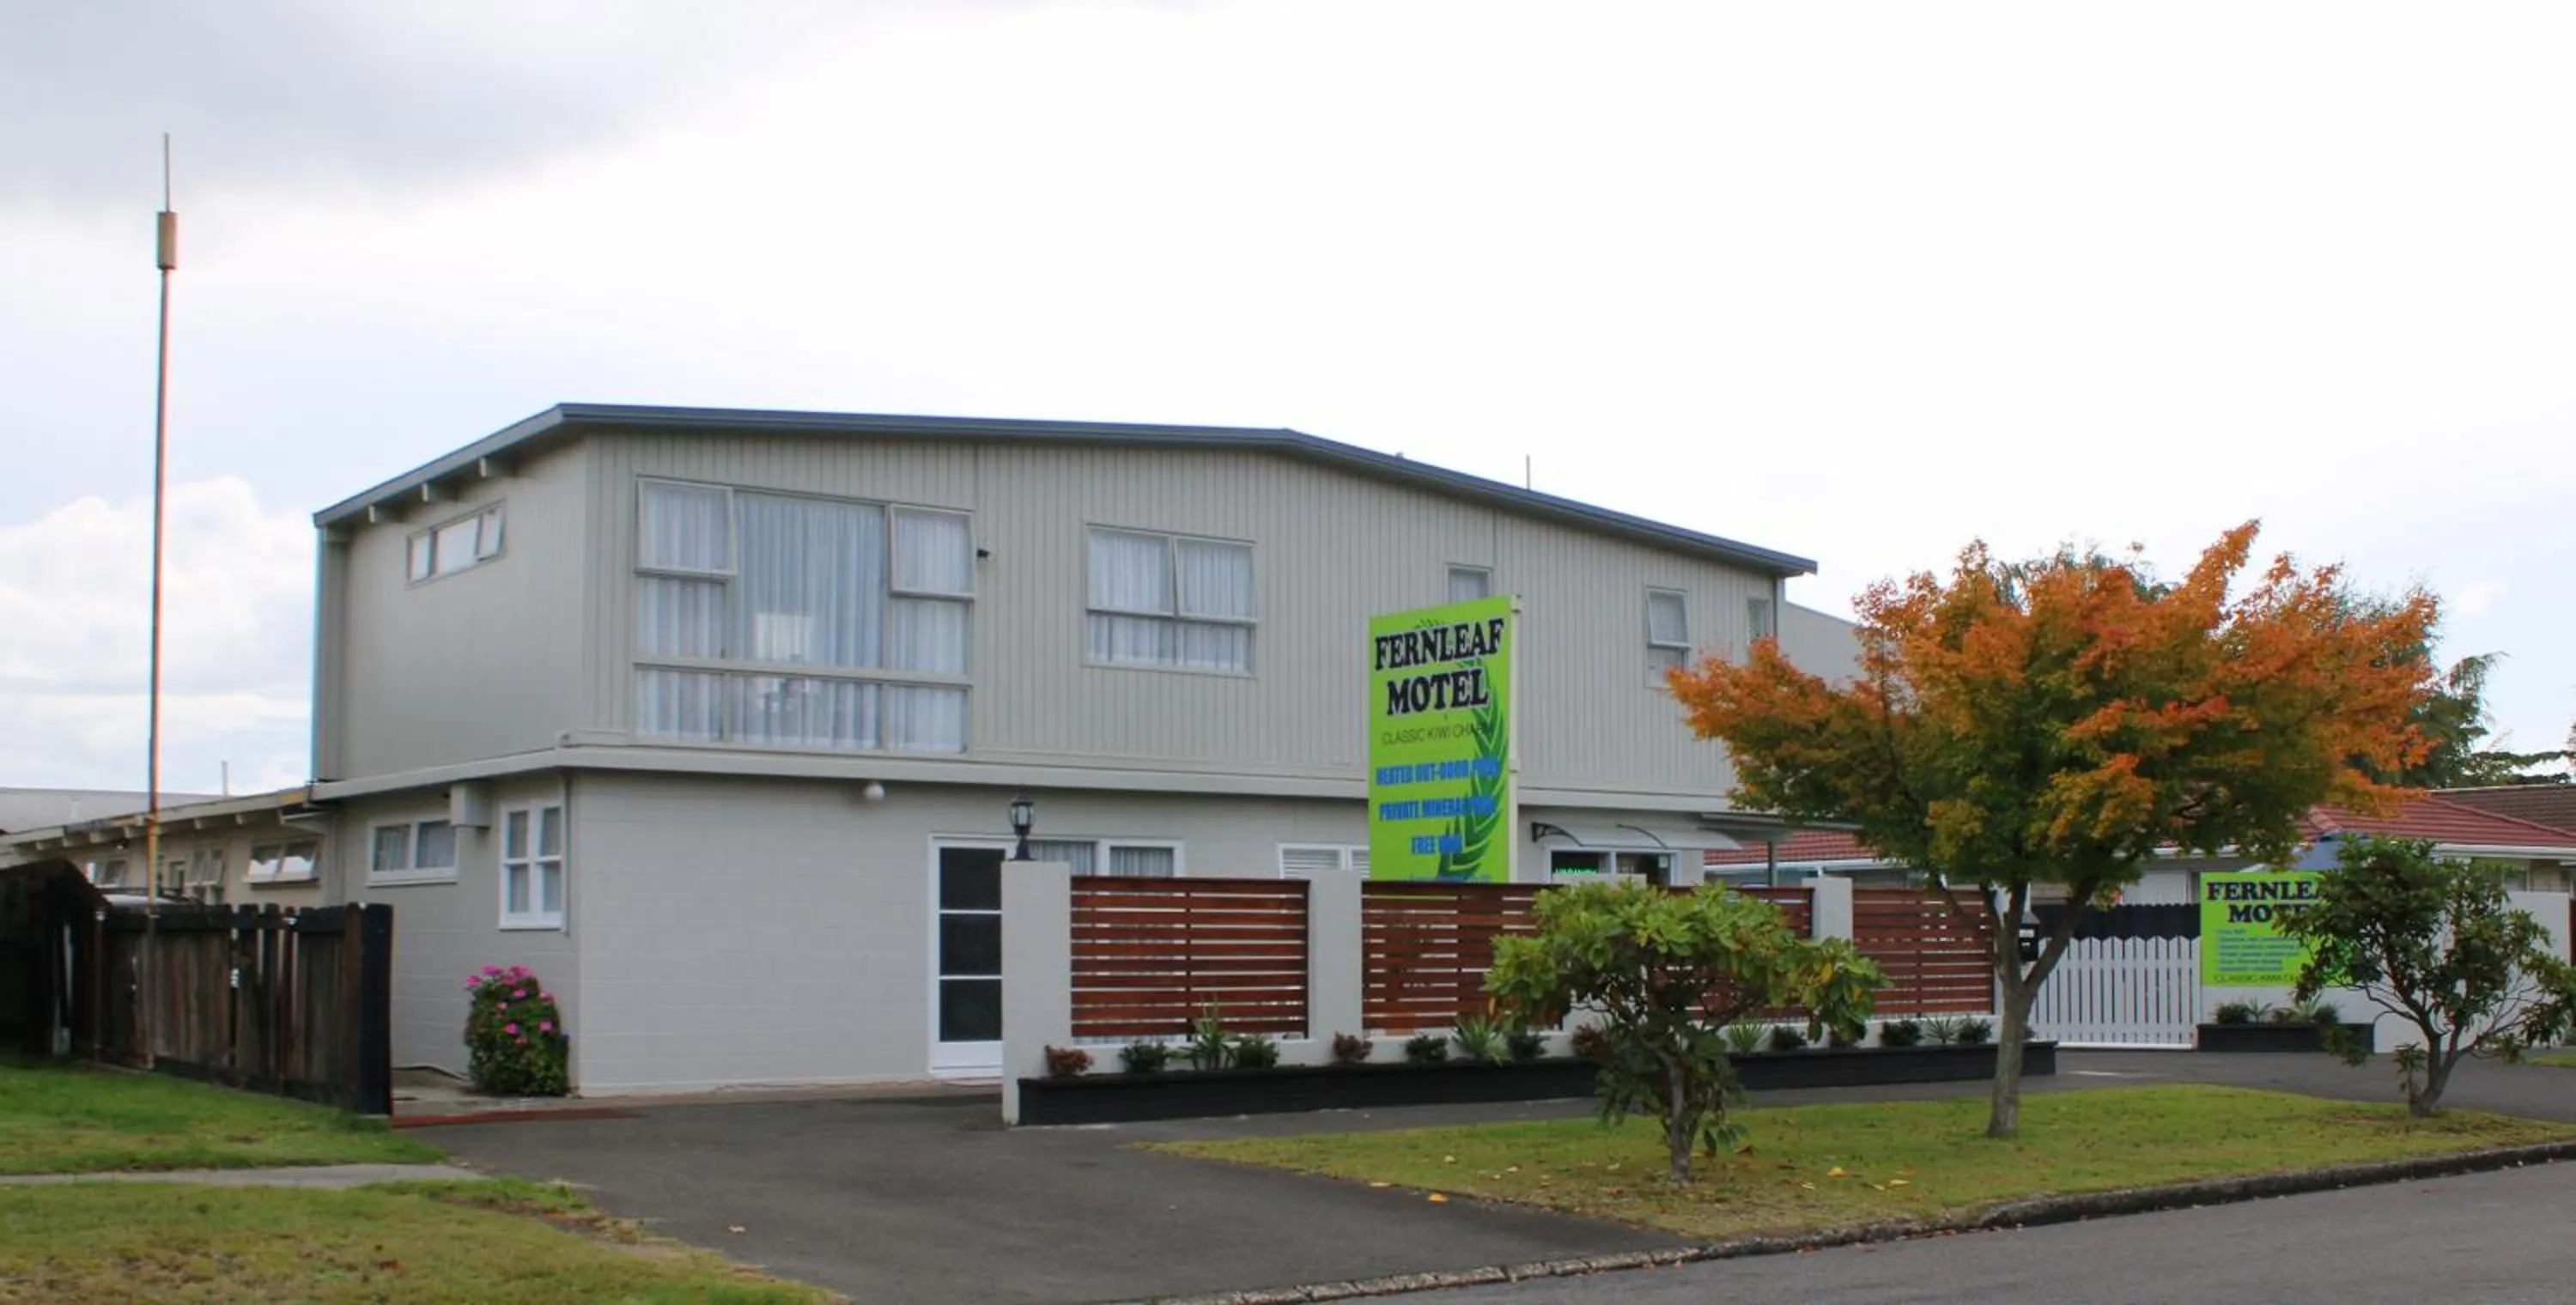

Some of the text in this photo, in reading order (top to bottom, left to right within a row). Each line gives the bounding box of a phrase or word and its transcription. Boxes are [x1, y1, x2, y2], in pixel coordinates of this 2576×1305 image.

[1375, 617, 1504, 671] FERNLEAF
[1387, 668, 1488, 716] MOTEL
[1381, 727, 1425, 745] CLASSIC
[1427, 725, 1450, 740] KIWI
[2207, 880, 2318, 901] FERNLE
